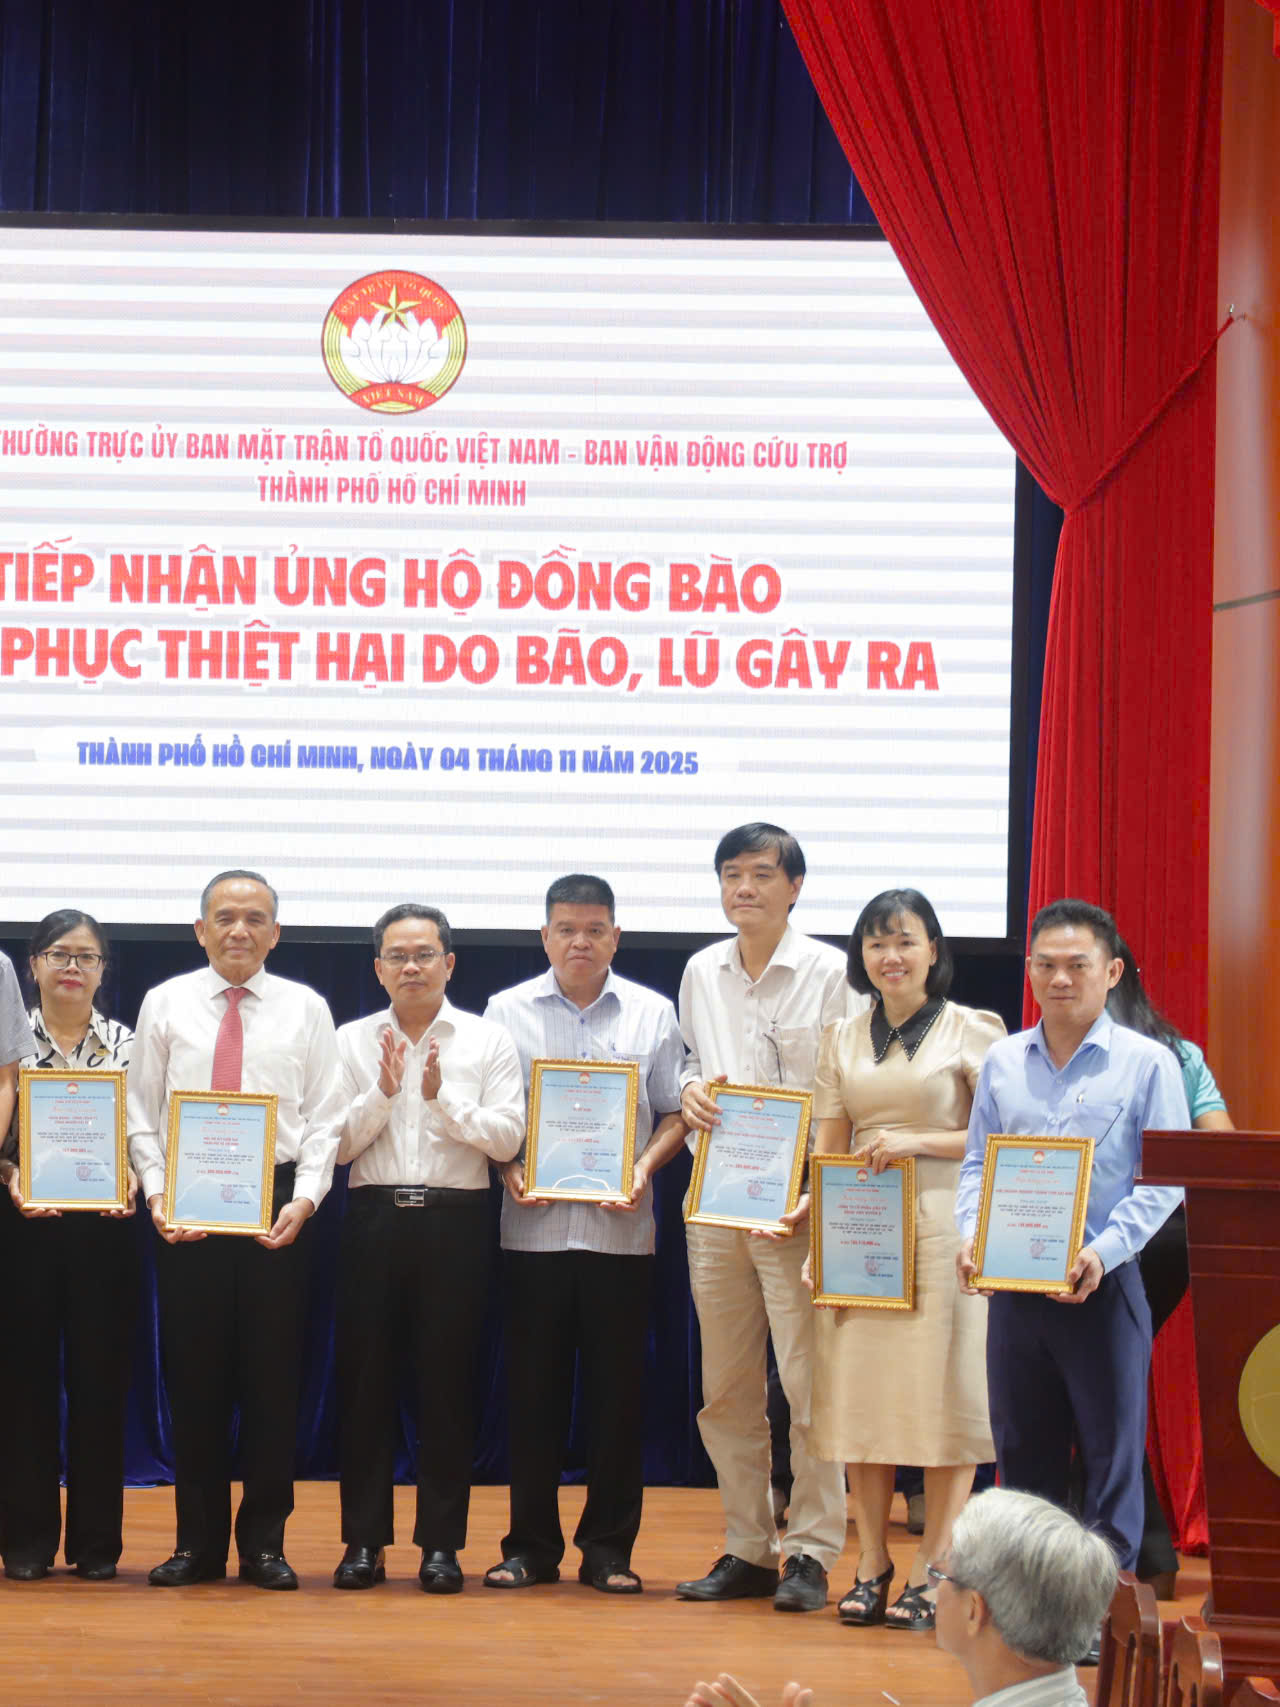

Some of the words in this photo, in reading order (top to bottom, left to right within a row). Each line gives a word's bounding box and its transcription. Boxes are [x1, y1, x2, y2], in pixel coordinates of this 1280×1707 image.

[86, 430, 143, 463] TRỰC
[152, 424, 178, 458] ỦY
[186, 433, 229, 459] BAN
[238, 428, 286, 465] MẶT
[294, 429, 348, 466] TRẬN
[357, 432, 383, 462] TỔ
[391, 433, 448, 464] QUỐC
[457, 432, 501, 470] VIỆT
[509, 438, 559, 464] NAM
[585, 440, 627, 466] BAN
[636, 434, 678, 472] VẬN
[687, 435, 744, 472] ĐỘNG
[753, 436, 798, 468] CỨU
[808, 441, 847, 474] TRỢ
[258, 470, 328, 503] THÀNH
[337, 473, 379, 504] PHỐ
[388, 473, 416, 504] HỒ
[425, 473, 460, 504] CHÍ
[468, 480, 526, 506] MINH
[110, 544, 256, 611] NHẬN
[274, 544, 386, 608] ỦNG
[404, 548, 482, 616] HỘ
[496, 544, 650, 612] ĐỒNG
[669, 554, 781, 614] BÀO
[0, 627, 142, 684] PHỤC
[158, 619, 300, 687] THIỆT
[316, 632, 405, 688] HẠI
[423, 633, 500, 685] DO
[516, 628, 643, 692] BÃO,
[658, 630, 720, 688] LŨ
[736, 628, 852, 689] GÂY
[867, 641, 939, 691] RA
[78, 737, 152, 766] THÀNH
[158, 734, 206, 766] PHỐ
[212, 735, 245, 767] HỒ
[251, 740, 291, 768] CHÍ
[298, 745, 364, 772] MINH,
[371, 742, 432, 770] NGÀY
[440, 747, 470, 771] 04
[478, 744, 552, 772] THÁNG
[560, 750, 576, 772] 11
[582, 745, 634, 774] NĂM
[641, 751, 698, 775] 2025
